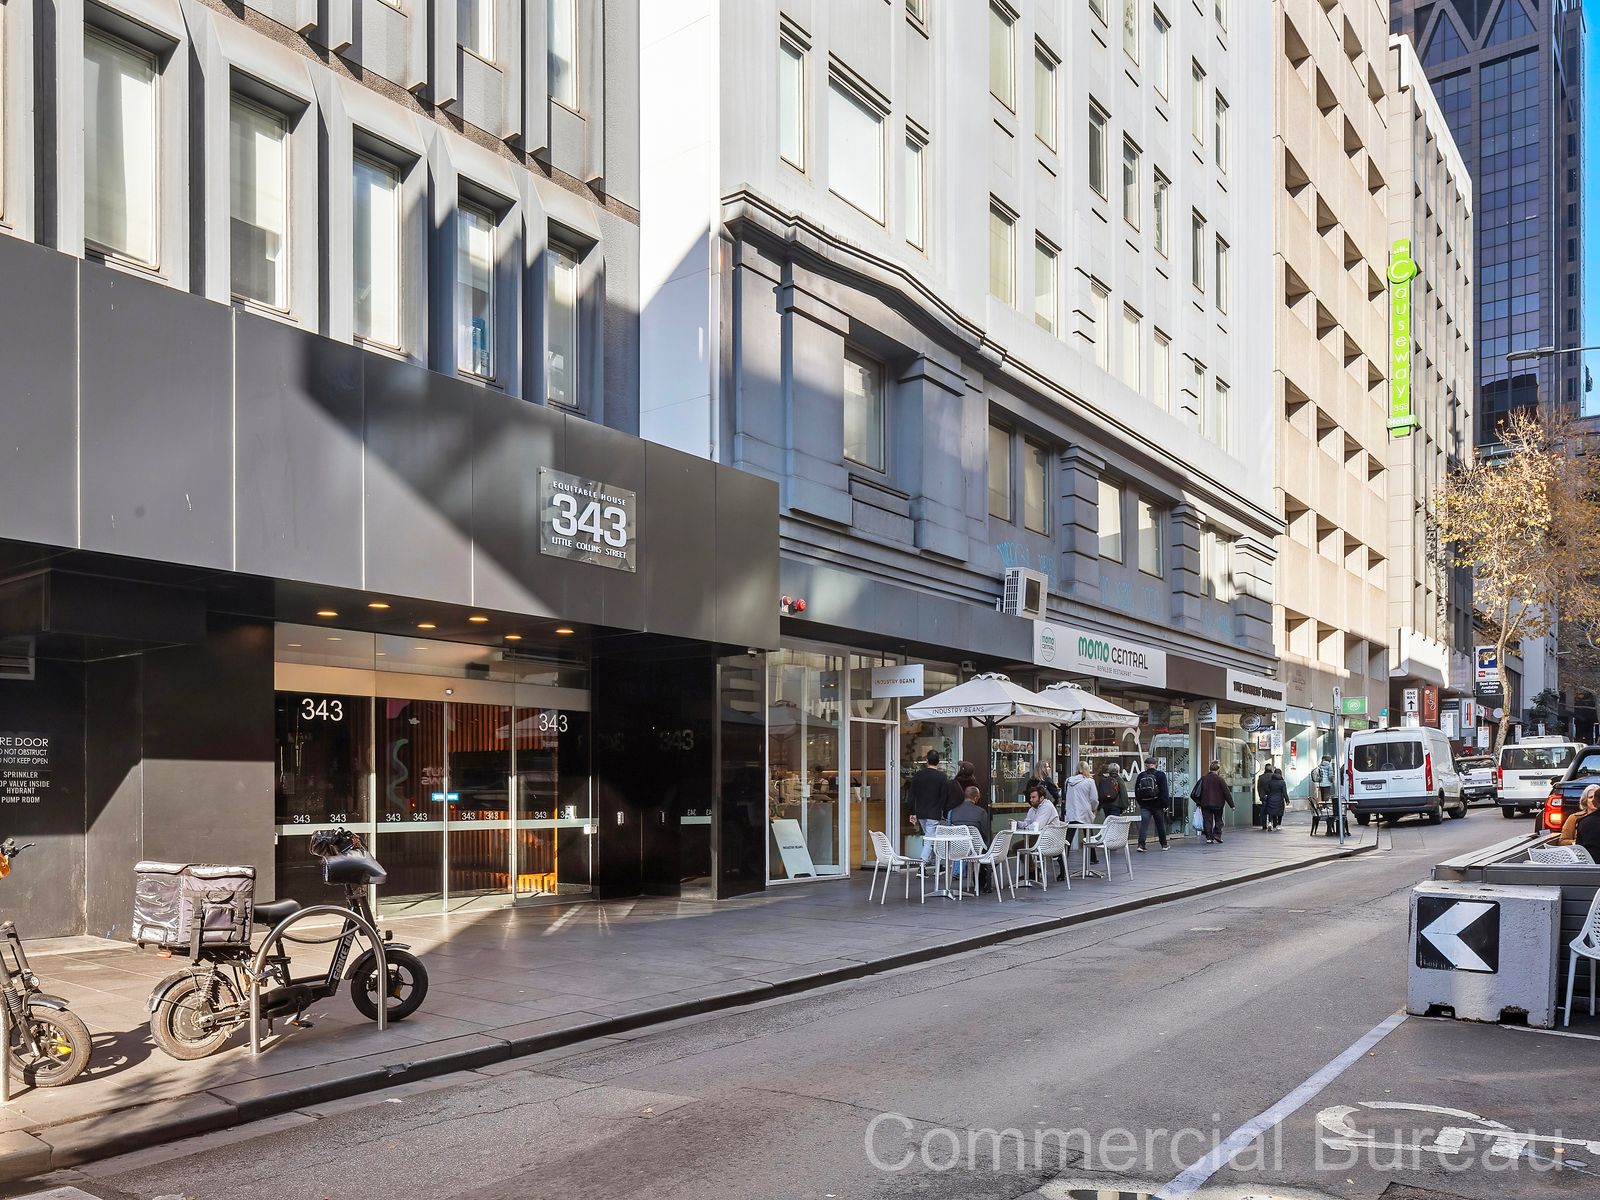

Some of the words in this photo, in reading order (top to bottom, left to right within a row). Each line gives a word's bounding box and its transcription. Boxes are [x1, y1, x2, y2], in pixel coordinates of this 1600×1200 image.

[1390, 260, 1410, 399] Causeway
[1389, 415, 1413, 427] Hotel
[553, 481, 598, 498] EQUITABLE
[601, 494, 626, 506] HOUSE
[552, 493, 627, 548] 343
[551, 536, 572, 547] LITTLE
[576, 541, 602, 554] COLLINS
[605, 548, 627, 559] STREET
[1111, 646, 1148, 670] CENTRAL
[301, 698, 343, 722] 343
[538, 713, 568, 732] 343
[15, 737, 49, 747] DOOR
[18, 748, 47, 756] OBSTRUCT
[293, 814, 311, 824] 343
[330, 813, 347, 823] 343
[386, 813, 401, 822] 343
[413, 812, 428, 821] 343
[461, 812, 475, 820] 343
[485, 811, 499, 820] 343
[534, 811, 548, 819] 343
